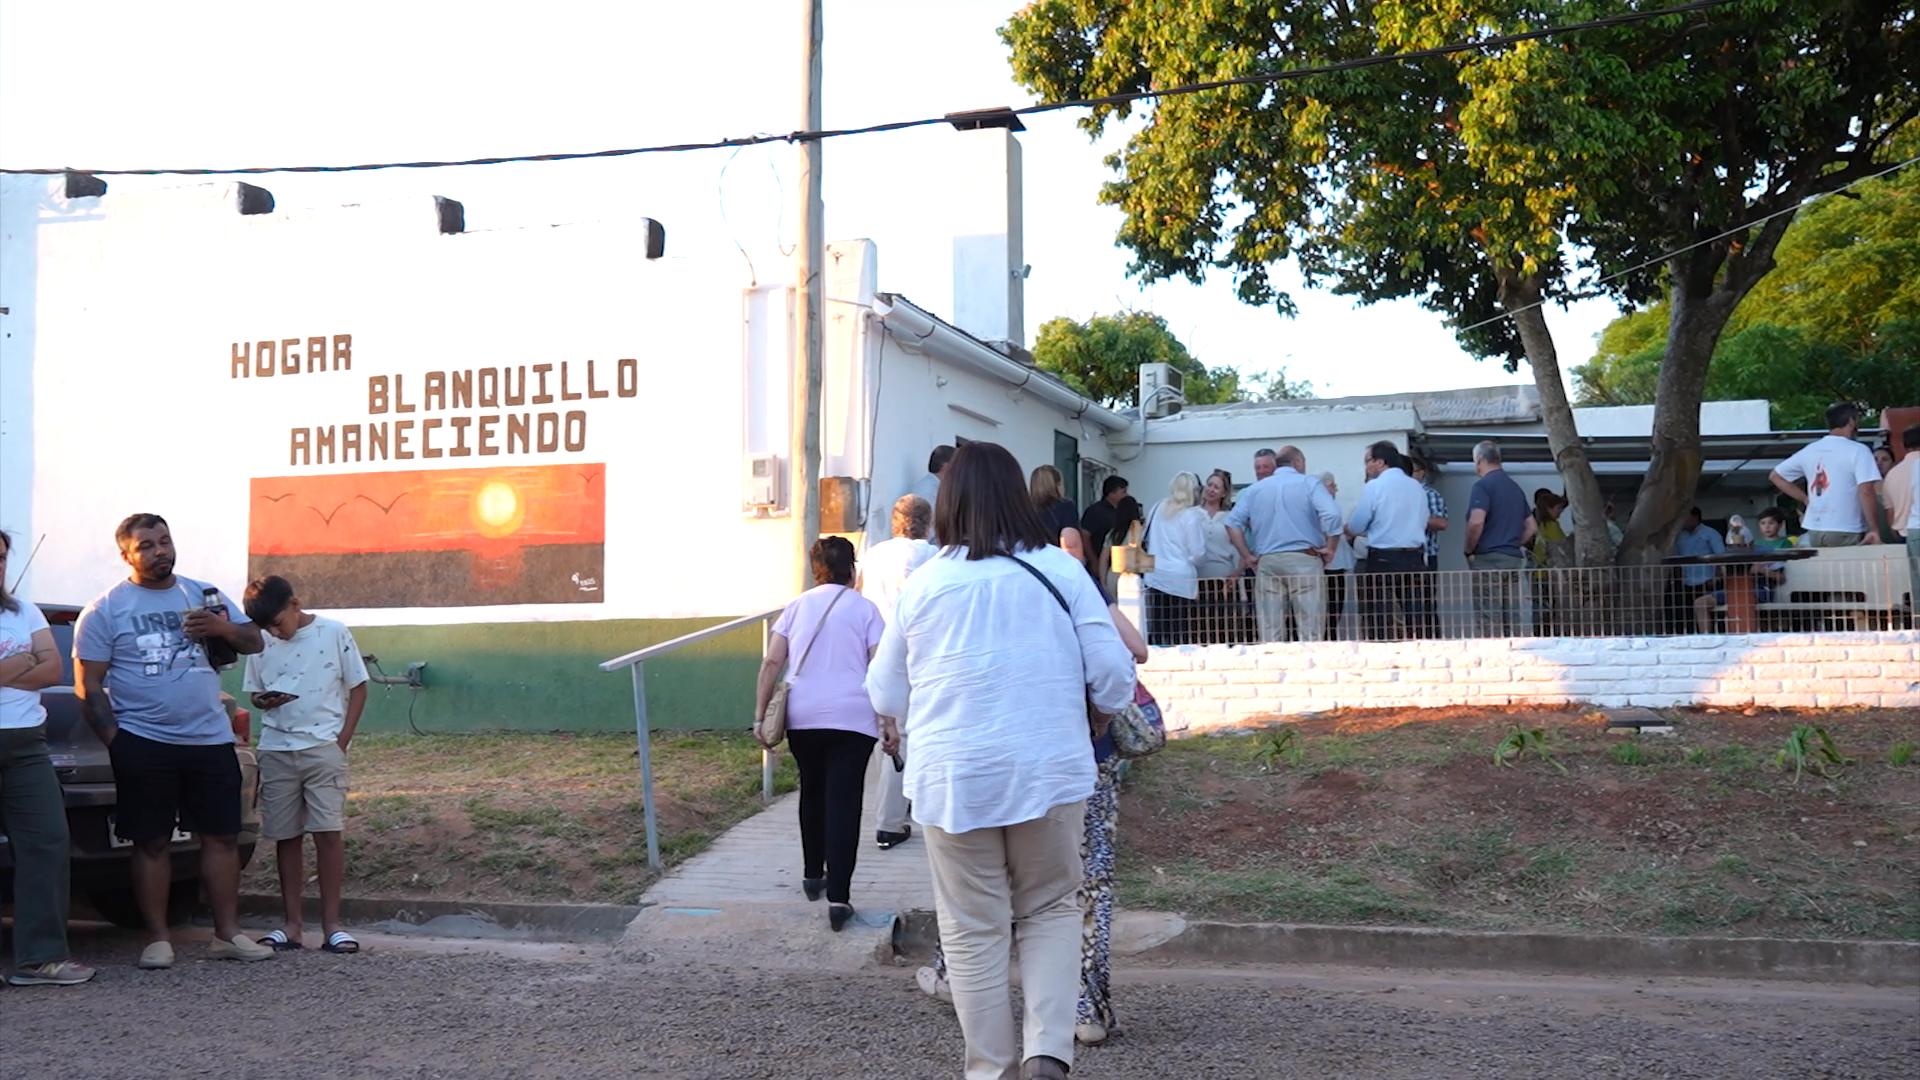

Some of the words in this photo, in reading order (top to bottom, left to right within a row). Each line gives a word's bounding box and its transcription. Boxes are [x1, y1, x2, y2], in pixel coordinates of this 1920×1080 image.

[231, 334, 352, 378] HOGAR
[369, 359, 638, 414] BLANQUILLO
[291, 411, 586, 466] AMANECIENDO
[131, 611, 184, 635] URB
